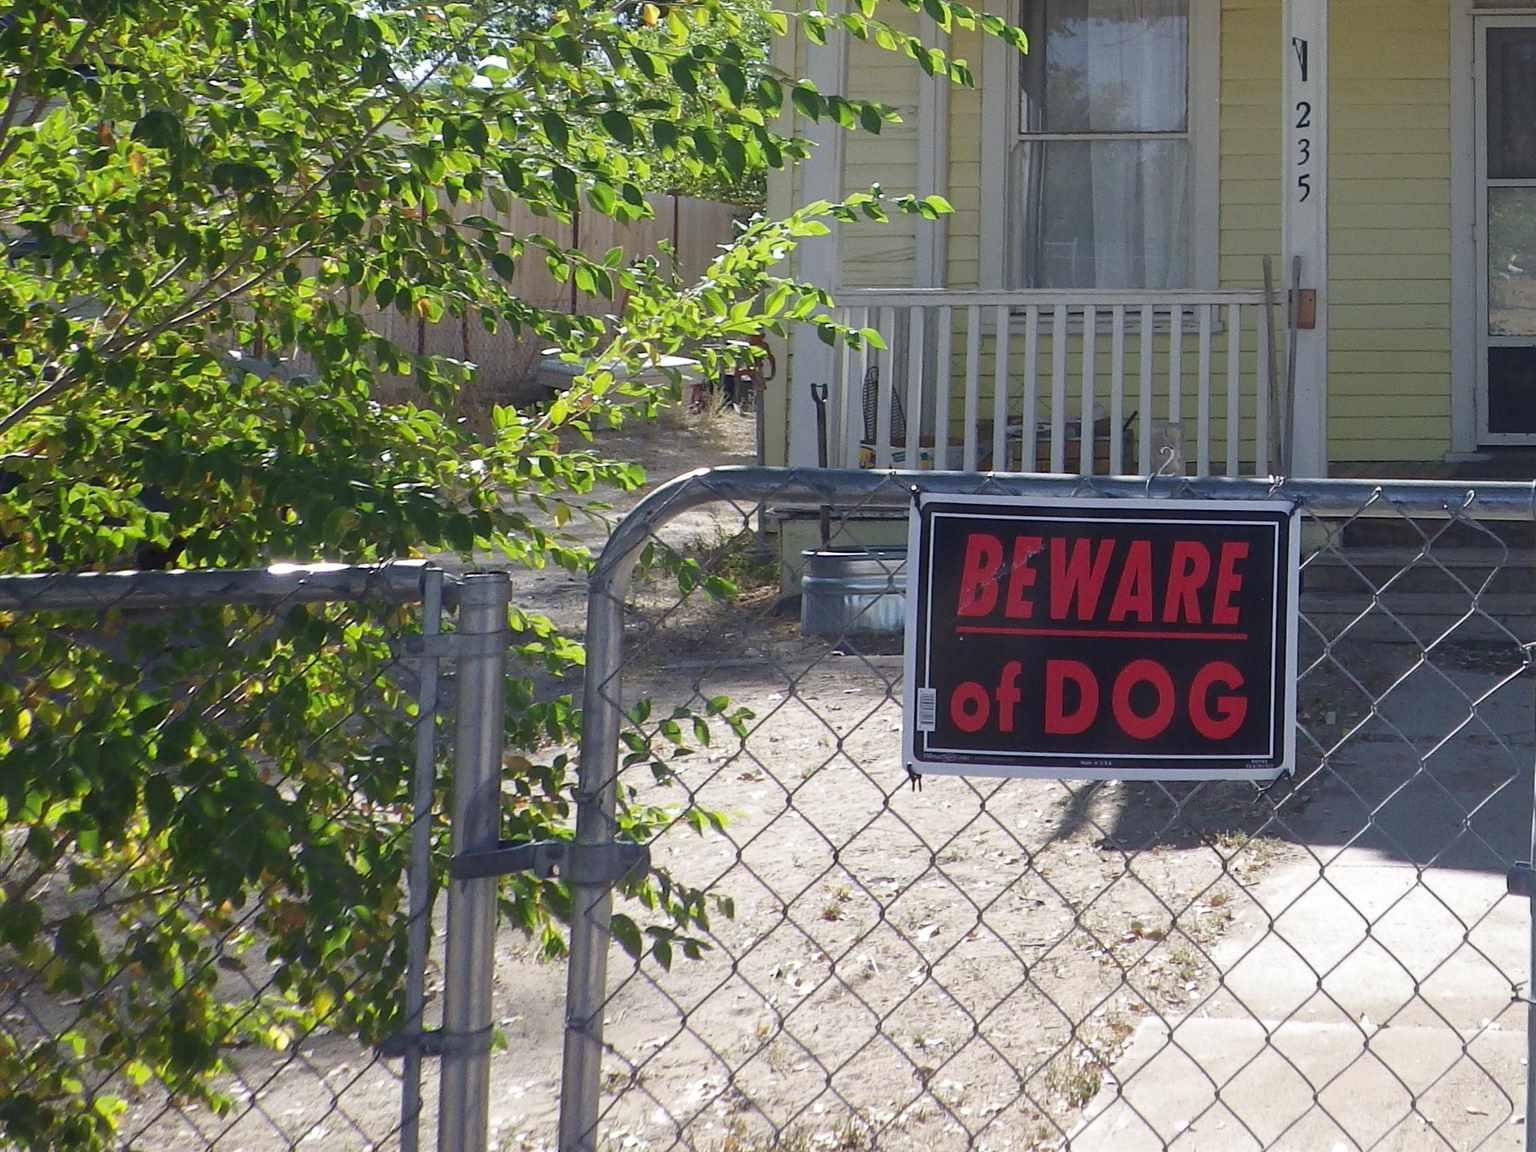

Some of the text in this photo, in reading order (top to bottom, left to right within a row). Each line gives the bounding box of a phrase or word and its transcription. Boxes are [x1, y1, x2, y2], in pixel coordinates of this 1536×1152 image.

[956, 533, 1250, 625] BEWARE
[949, 658, 1249, 740] of DOG
